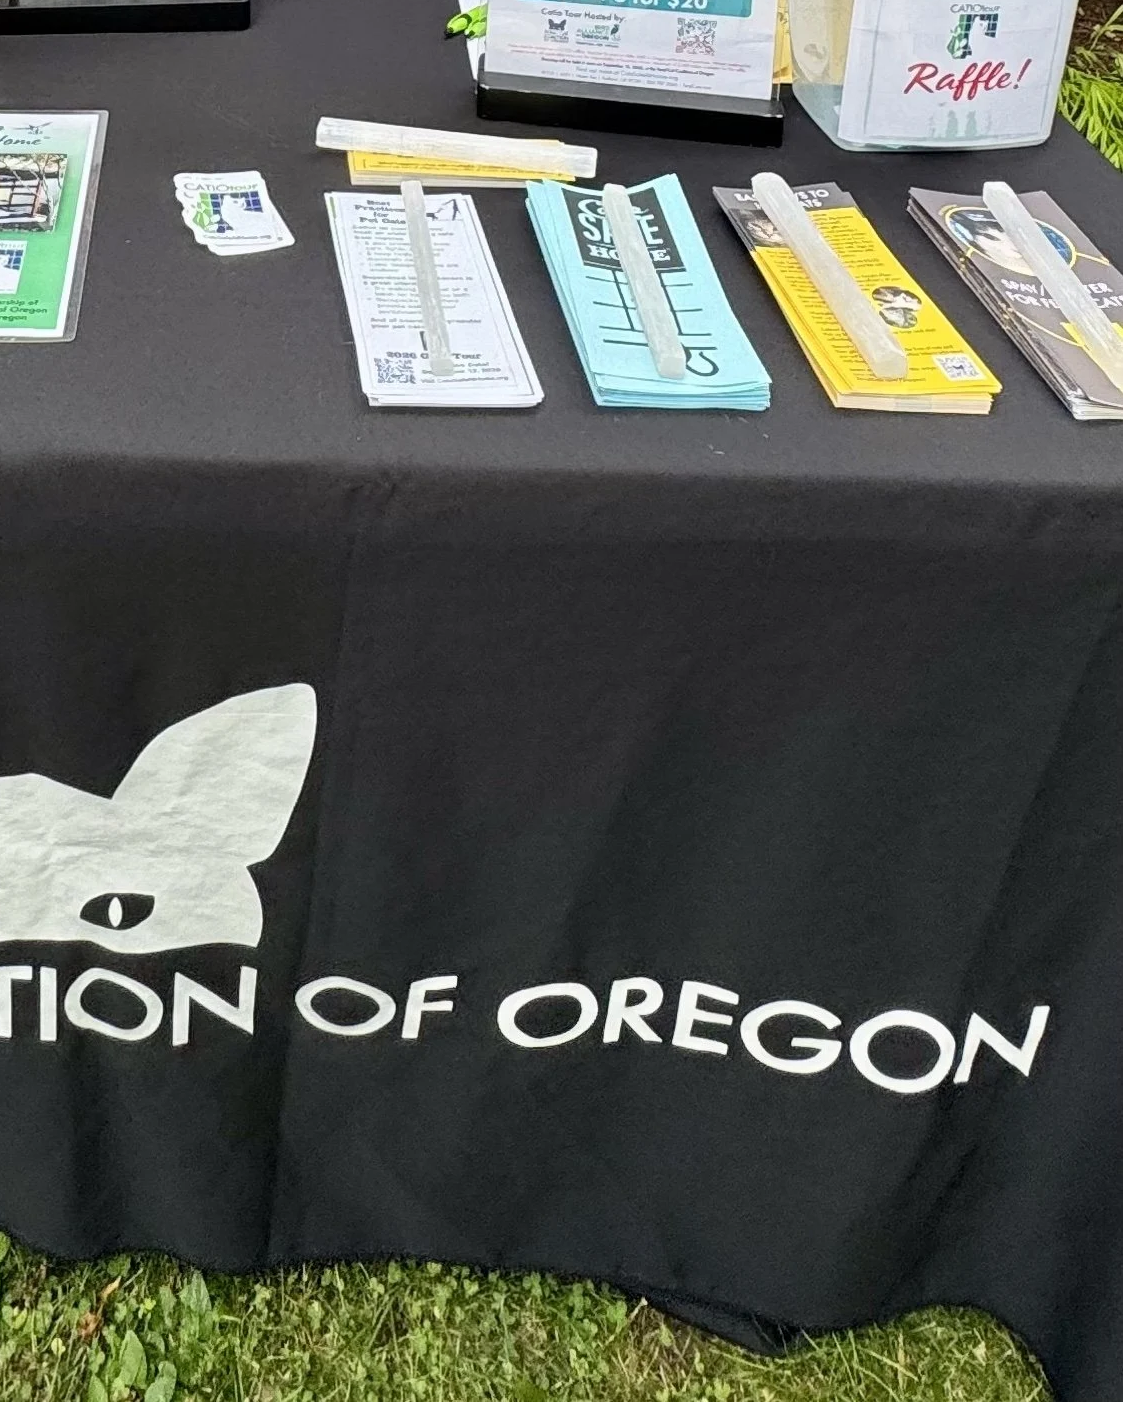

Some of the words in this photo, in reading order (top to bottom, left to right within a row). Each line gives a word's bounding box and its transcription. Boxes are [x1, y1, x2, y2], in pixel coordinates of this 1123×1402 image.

[903, 58, 1033, 102] Raffle!
[9, 306, 48, 315] Oregon
[295, 974, 458, 1042] OF
[496, 976, 1051, 1094] OREGON
